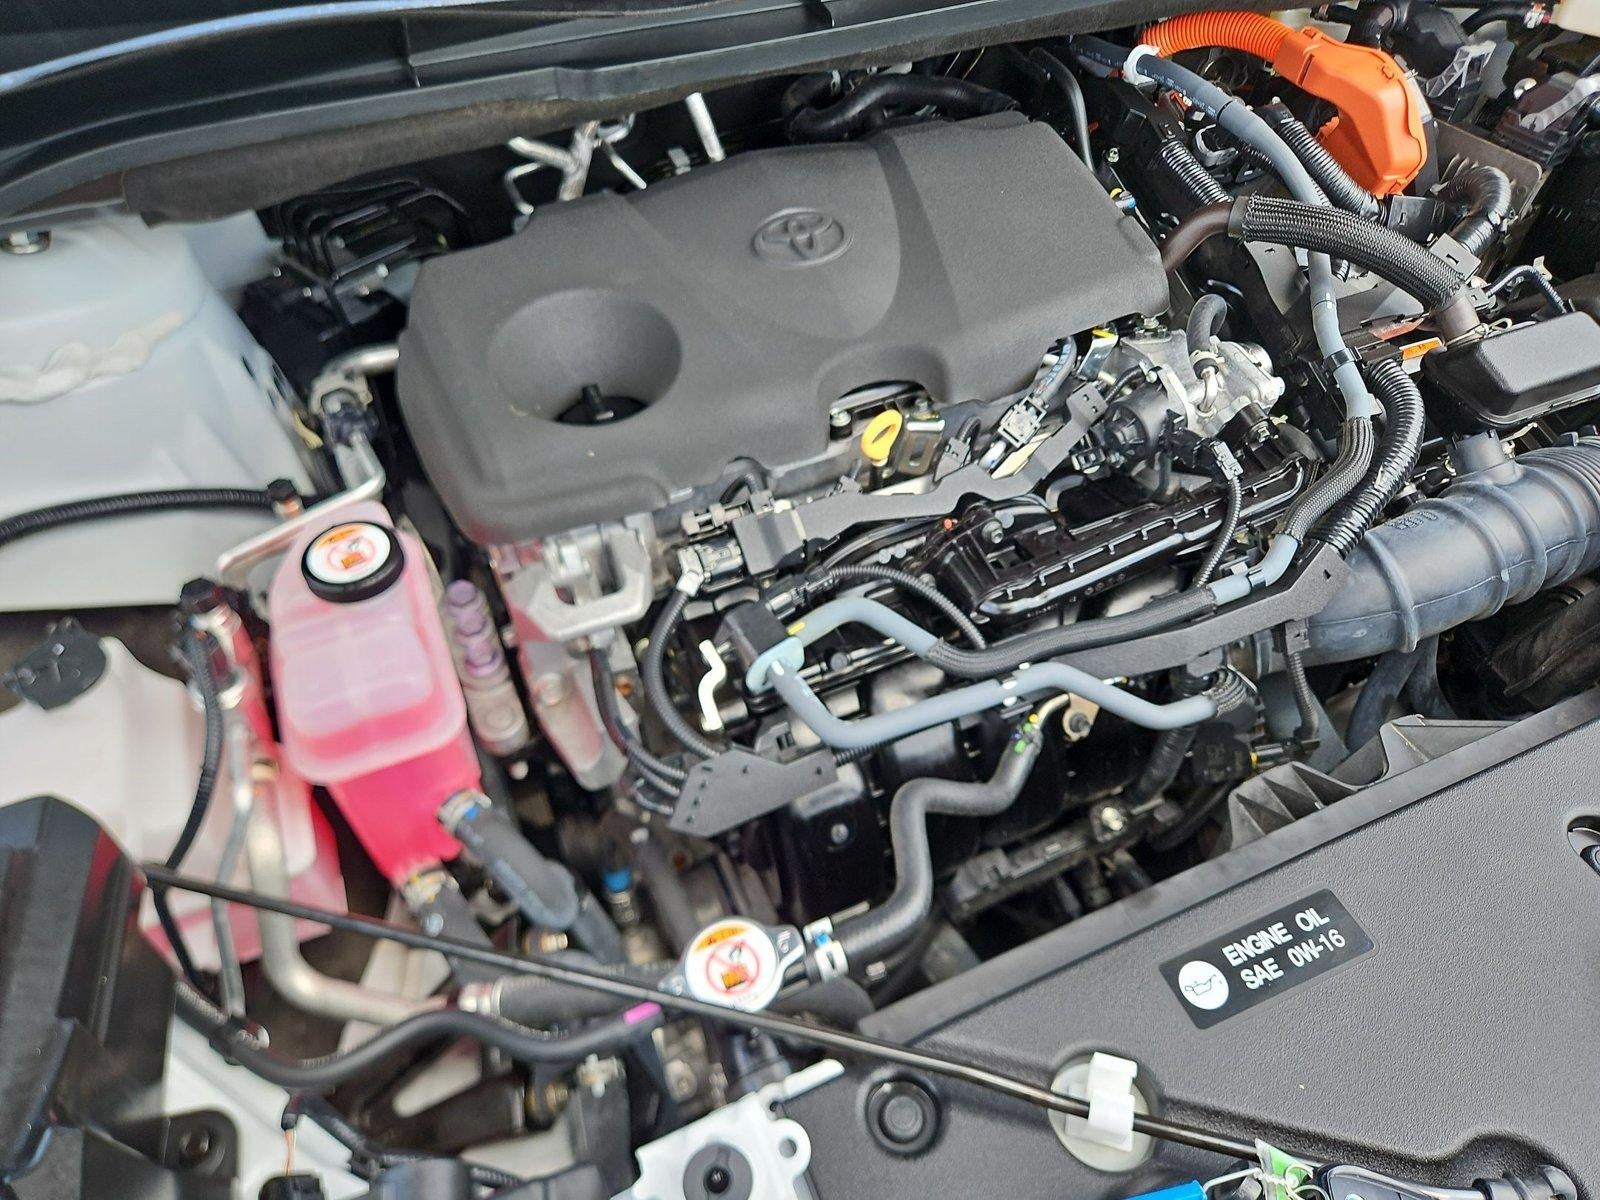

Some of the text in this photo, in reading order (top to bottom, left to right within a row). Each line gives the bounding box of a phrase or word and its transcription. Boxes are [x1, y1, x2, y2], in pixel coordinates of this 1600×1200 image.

[1222, 907, 1330, 966] ENGINE OIL
[1240, 929, 1345, 989] SAE 0W-16
